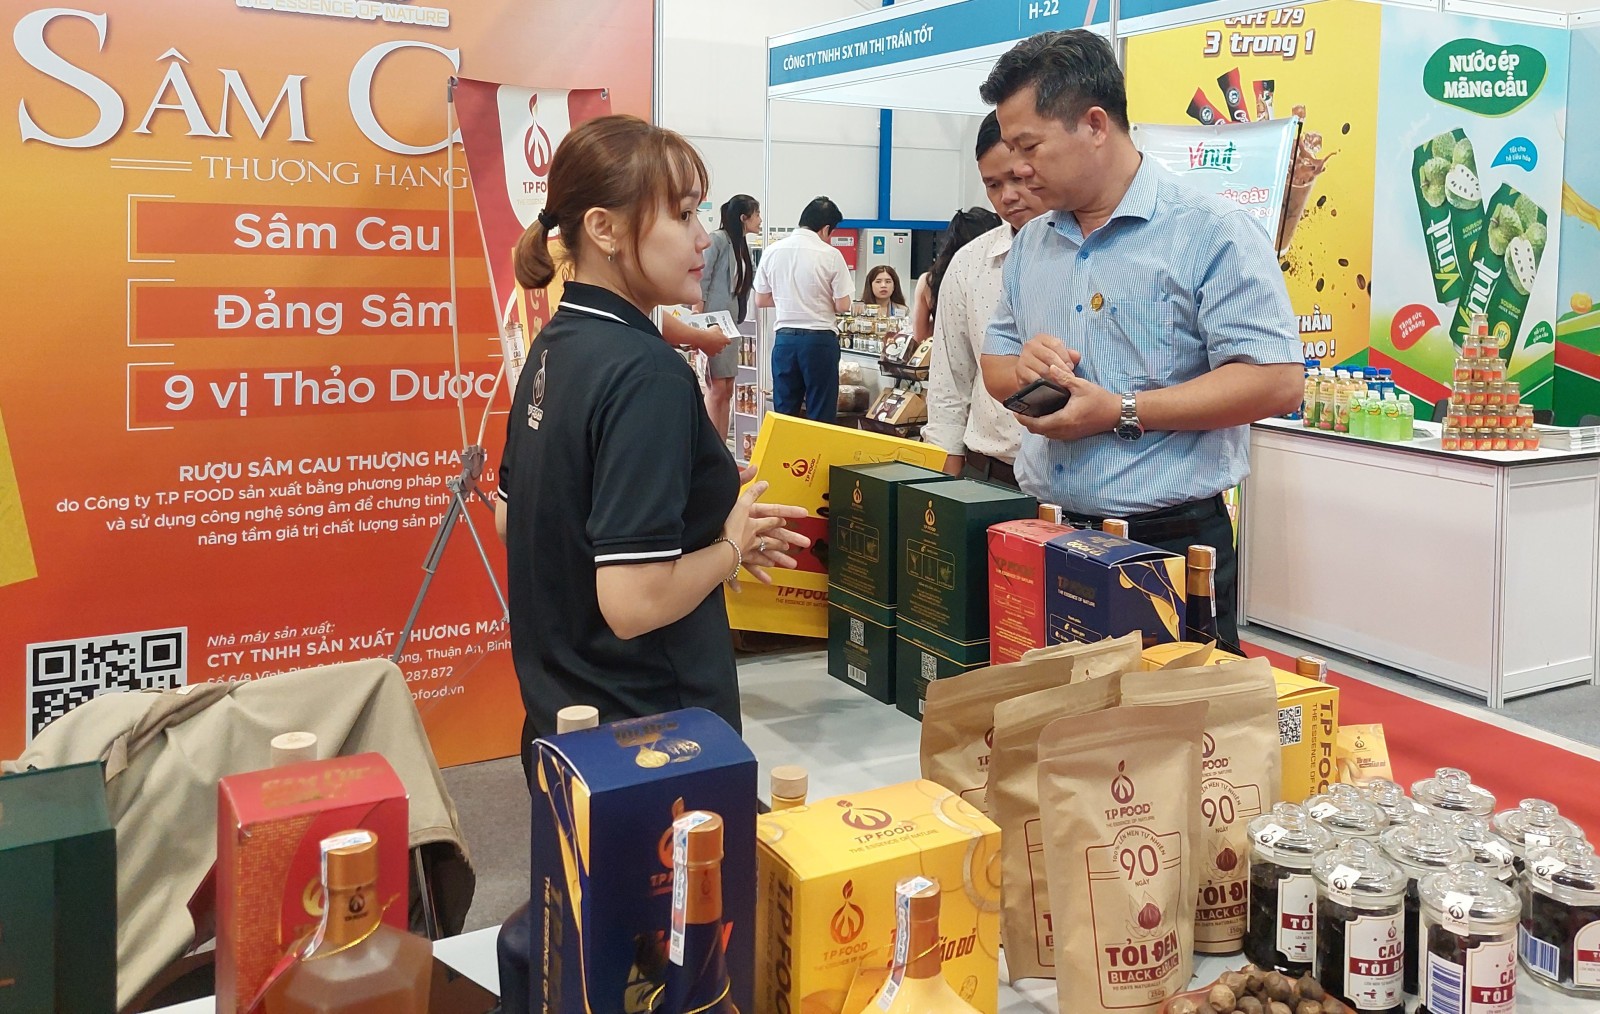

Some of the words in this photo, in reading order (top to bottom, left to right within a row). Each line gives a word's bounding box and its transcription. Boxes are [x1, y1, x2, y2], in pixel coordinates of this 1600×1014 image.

[358, 4, 381, 17] OF
[386, 6, 447, 24] NATURE
[1028, 1, 1059, 21] H-22
[1271, 7, 1305, 25] J79
[783, 53, 805, 71] CÔNG
[806, 53, 817, 67] TY
[817, 48, 841, 65] TNHH
[841, 46, 853, 61] SX
[853, 42, 868, 58] TM
[869, 39, 885, 56] THỊ
[886, 30, 913, 51] TRẤN
[913, 22, 934, 46] TỐT
[1203, 30, 1222, 54] 3
[1230, 32, 1298, 57] trong
[1304, 29, 1315, 52] 1
[13, 7, 316, 148] SÂM
[348, 39, 465, 156] C
[201, 155, 361, 187] THƯỢNG
[374, 163, 469, 191] HẠNG
[234, 213, 337, 250] Sâm
[356, 216, 440, 251] Cau
[214, 288, 343, 335] Đảng
[361, 292, 454, 328] Sâm
[164, 374, 195, 411] 9
[210, 372, 248, 416] vị
[264, 365, 376, 406] Thảo
[179, 462, 242, 483] RƯỢU
[248, 457, 293, 478] SÂM
[298, 456, 341, 475] CAU
[346, 451, 429, 472] THƯỢNG
[56, 498, 80, 512] do
[84, 496, 130, 511] Công
[134, 494, 151, 508] ty
[155, 491, 179, 506] T.P
[184, 488, 234, 504] FOOD
[238, 484, 265, 499] sản
[269, 482, 302, 498] xuất
[306, 478, 343, 495] bằng
[347, 476, 403, 494] phương
[406, 472, 441, 490] pháp
[106, 516, 126, 531] và
[130, 513, 150, 529] sử
[154, 513, 196, 530] dụng
[200, 509, 240, 525] công
[244, 505, 284, 522] nghệ
[287, 503, 324, 519] sóng
[327, 501, 351, 515] âm
[354, 496, 373, 512] để
[376, 496, 421, 511] chưng
[424, 492, 450, 506] tinh
[198, 531, 237, 546] nâng
[241, 527, 271, 543] tầm
[276, 525, 300, 541] giá
[303, 524, 319, 539] trị
[323, 518, 354, 535] chất
[358, 516, 398, 534] lượng
[402, 513, 426, 528] sản
[206, 634, 235, 648] Nhà
[239, 632, 270, 647] máy
[273, 627, 298, 641] sản
[301, 622, 336, 638] xuất:
[207, 651, 245, 668] CTY
[250, 644, 301, 662] TNHH
[306, 636, 344, 656] SẢN
[349, 629, 395, 651] XUẤT
[400, 623, 471, 643] HƯƠNG
[476, 619, 505, 636] MẠI
[426, 645, 462, 660] Thuận
[1119, 803, 1151, 819] FOOD
[1201, 794, 1235, 827] 90
[855, 833, 874, 845] T.P
[876, 825, 914, 840] FOOD
[1120, 844, 1159, 881] 90
[777, 880, 794, 937] T.P
[1105, 938, 1148, 967] TỎI
[1151, 929, 1178, 962] ĐEN
[775, 934, 793, 1014] FOO
[1110, 969, 1152, 984] BLACK
